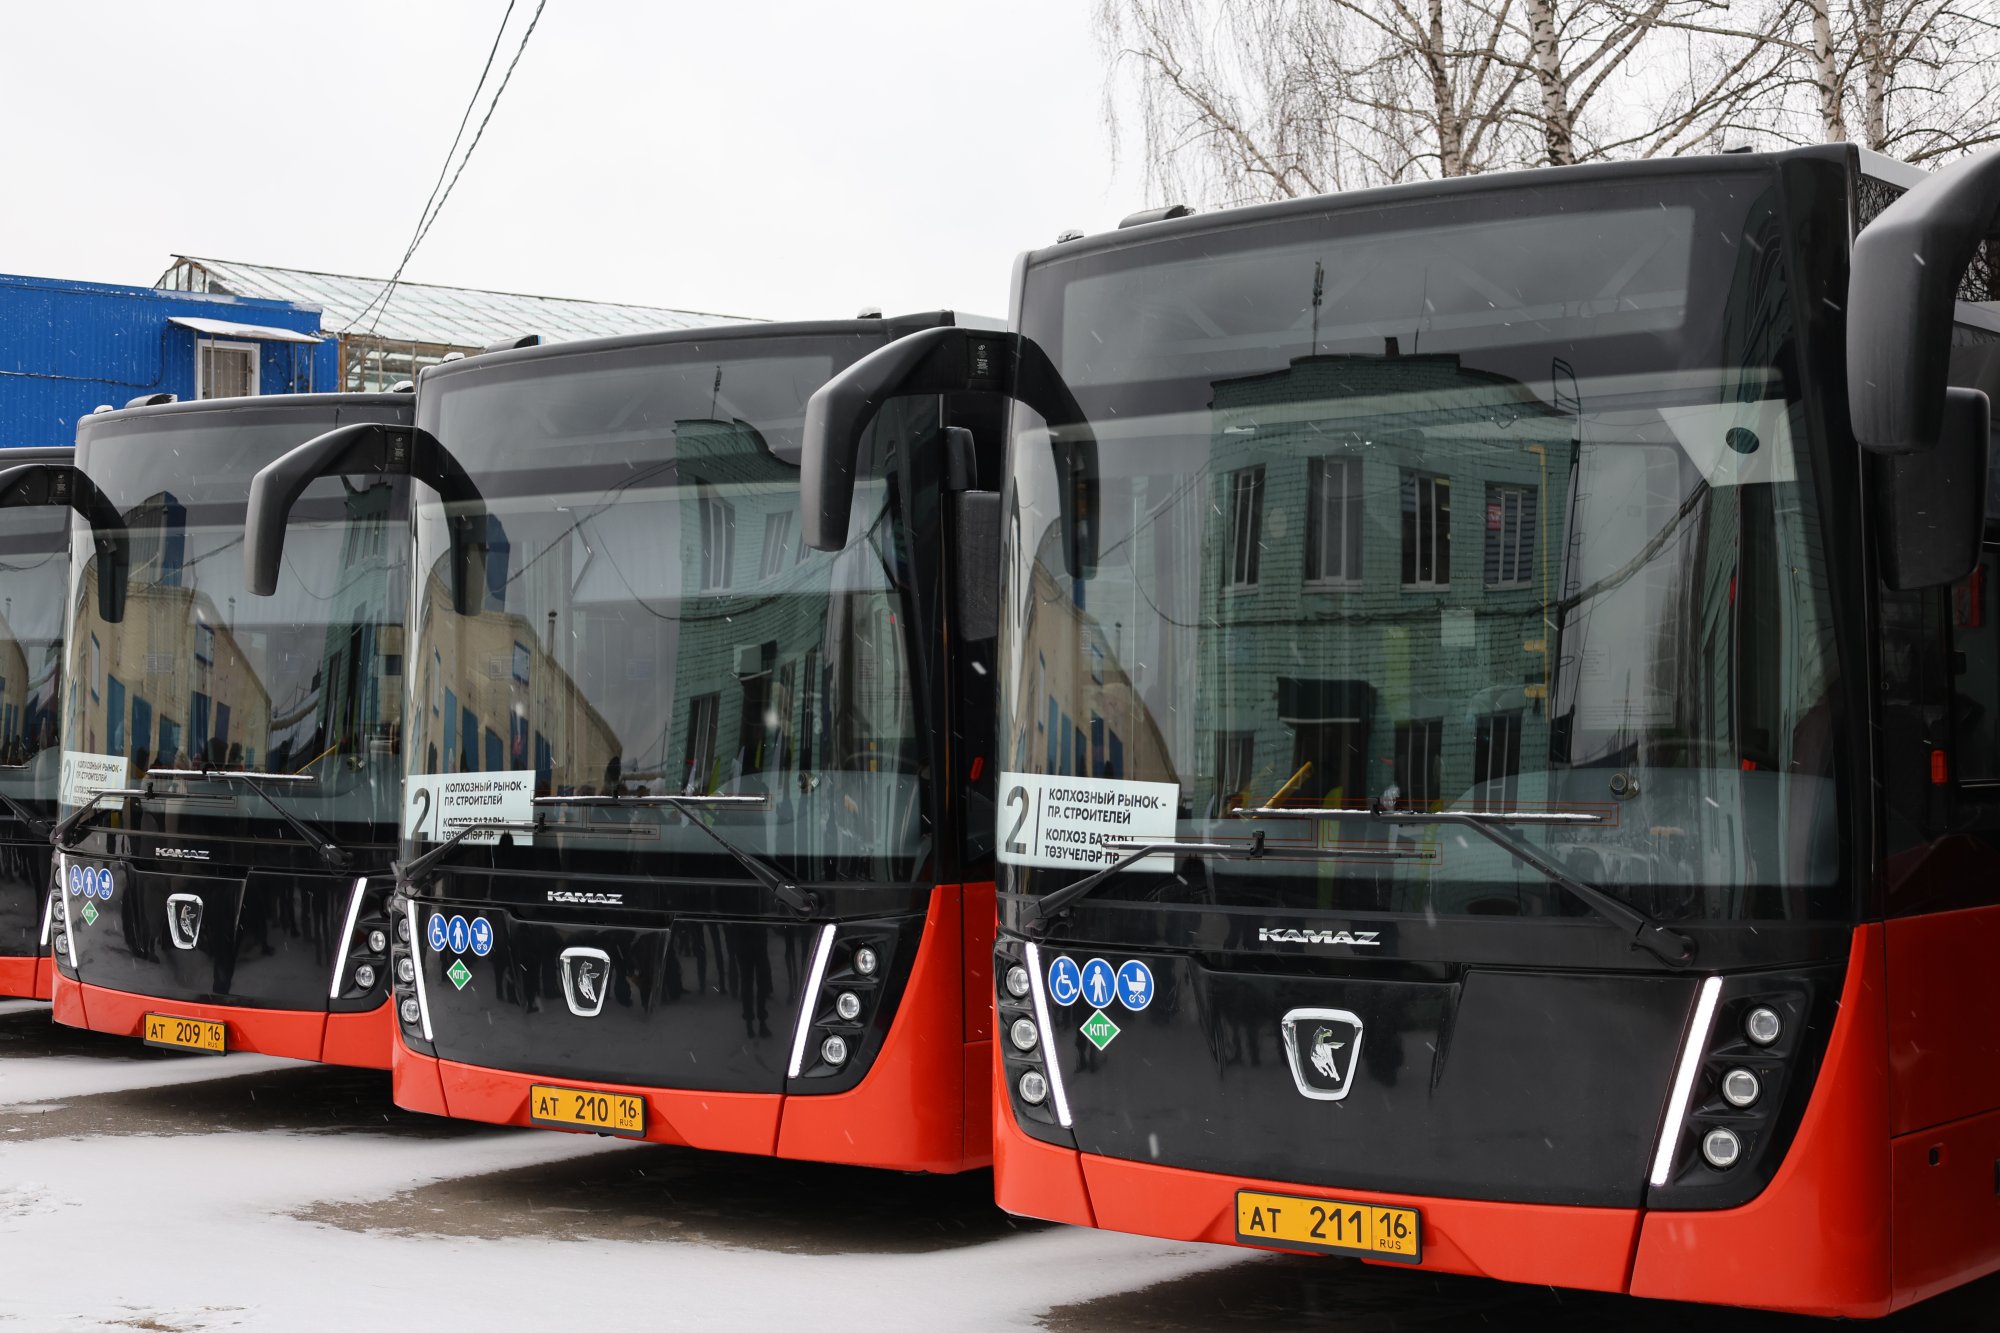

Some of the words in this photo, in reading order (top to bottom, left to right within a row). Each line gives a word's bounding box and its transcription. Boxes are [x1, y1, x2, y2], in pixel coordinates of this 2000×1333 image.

[445, 780, 492, 793] КОЛХОЗНЫЙ
[493, 781, 522, 792] РЫНОК
[444, 796, 455, 806] ПР.
[456, 793, 503, 806] СТРОИТЕЛЕЙ
[1049, 788, 1116, 806] КОЛХОЗНЫЙ
[1117, 793, 1159, 810] РЫНОК
[411, 787, 430, 840] 2
[1005, 785, 1030, 855] 2
[1047, 805, 1061, 818] ПР.
[1063, 806, 1131, 824] СТРОИТЕЛЕЙ
[442, 831, 483, 841] ТӨЗЛӘР
[484, 830, 495, 841] ПР.
[1046, 828, 1087, 844] КОЛХОЗ
[155, 847, 210, 860] KAMAZ
[1044, 845, 1102, 863] ТӨЗҮЧЕЛӘР
[547, 890, 623, 904] KAMAZ
[1259, 928, 1380, 945] KAMAZ
[453, 969, 466, 979] КПГ
[151, 1023, 165, 1038] АТ
[176, 1022, 200, 1043] 209
[208, 1025, 220, 1041] 16
[1089, 1023, 1111, 1037] КПГ
[540, 1096, 559, 1116] АТ
[575, 1095, 608, 1122] 210
[619, 1099, 637, 1119] 16
[620, 1119, 633, 1127] RUS
[1250, 1206, 1281, 1233] АТ
[1309, 1205, 1362, 1243] 211
[1379, 1212, 1408, 1239] 16
[1379, 1239, 1401, 1250] RUS
